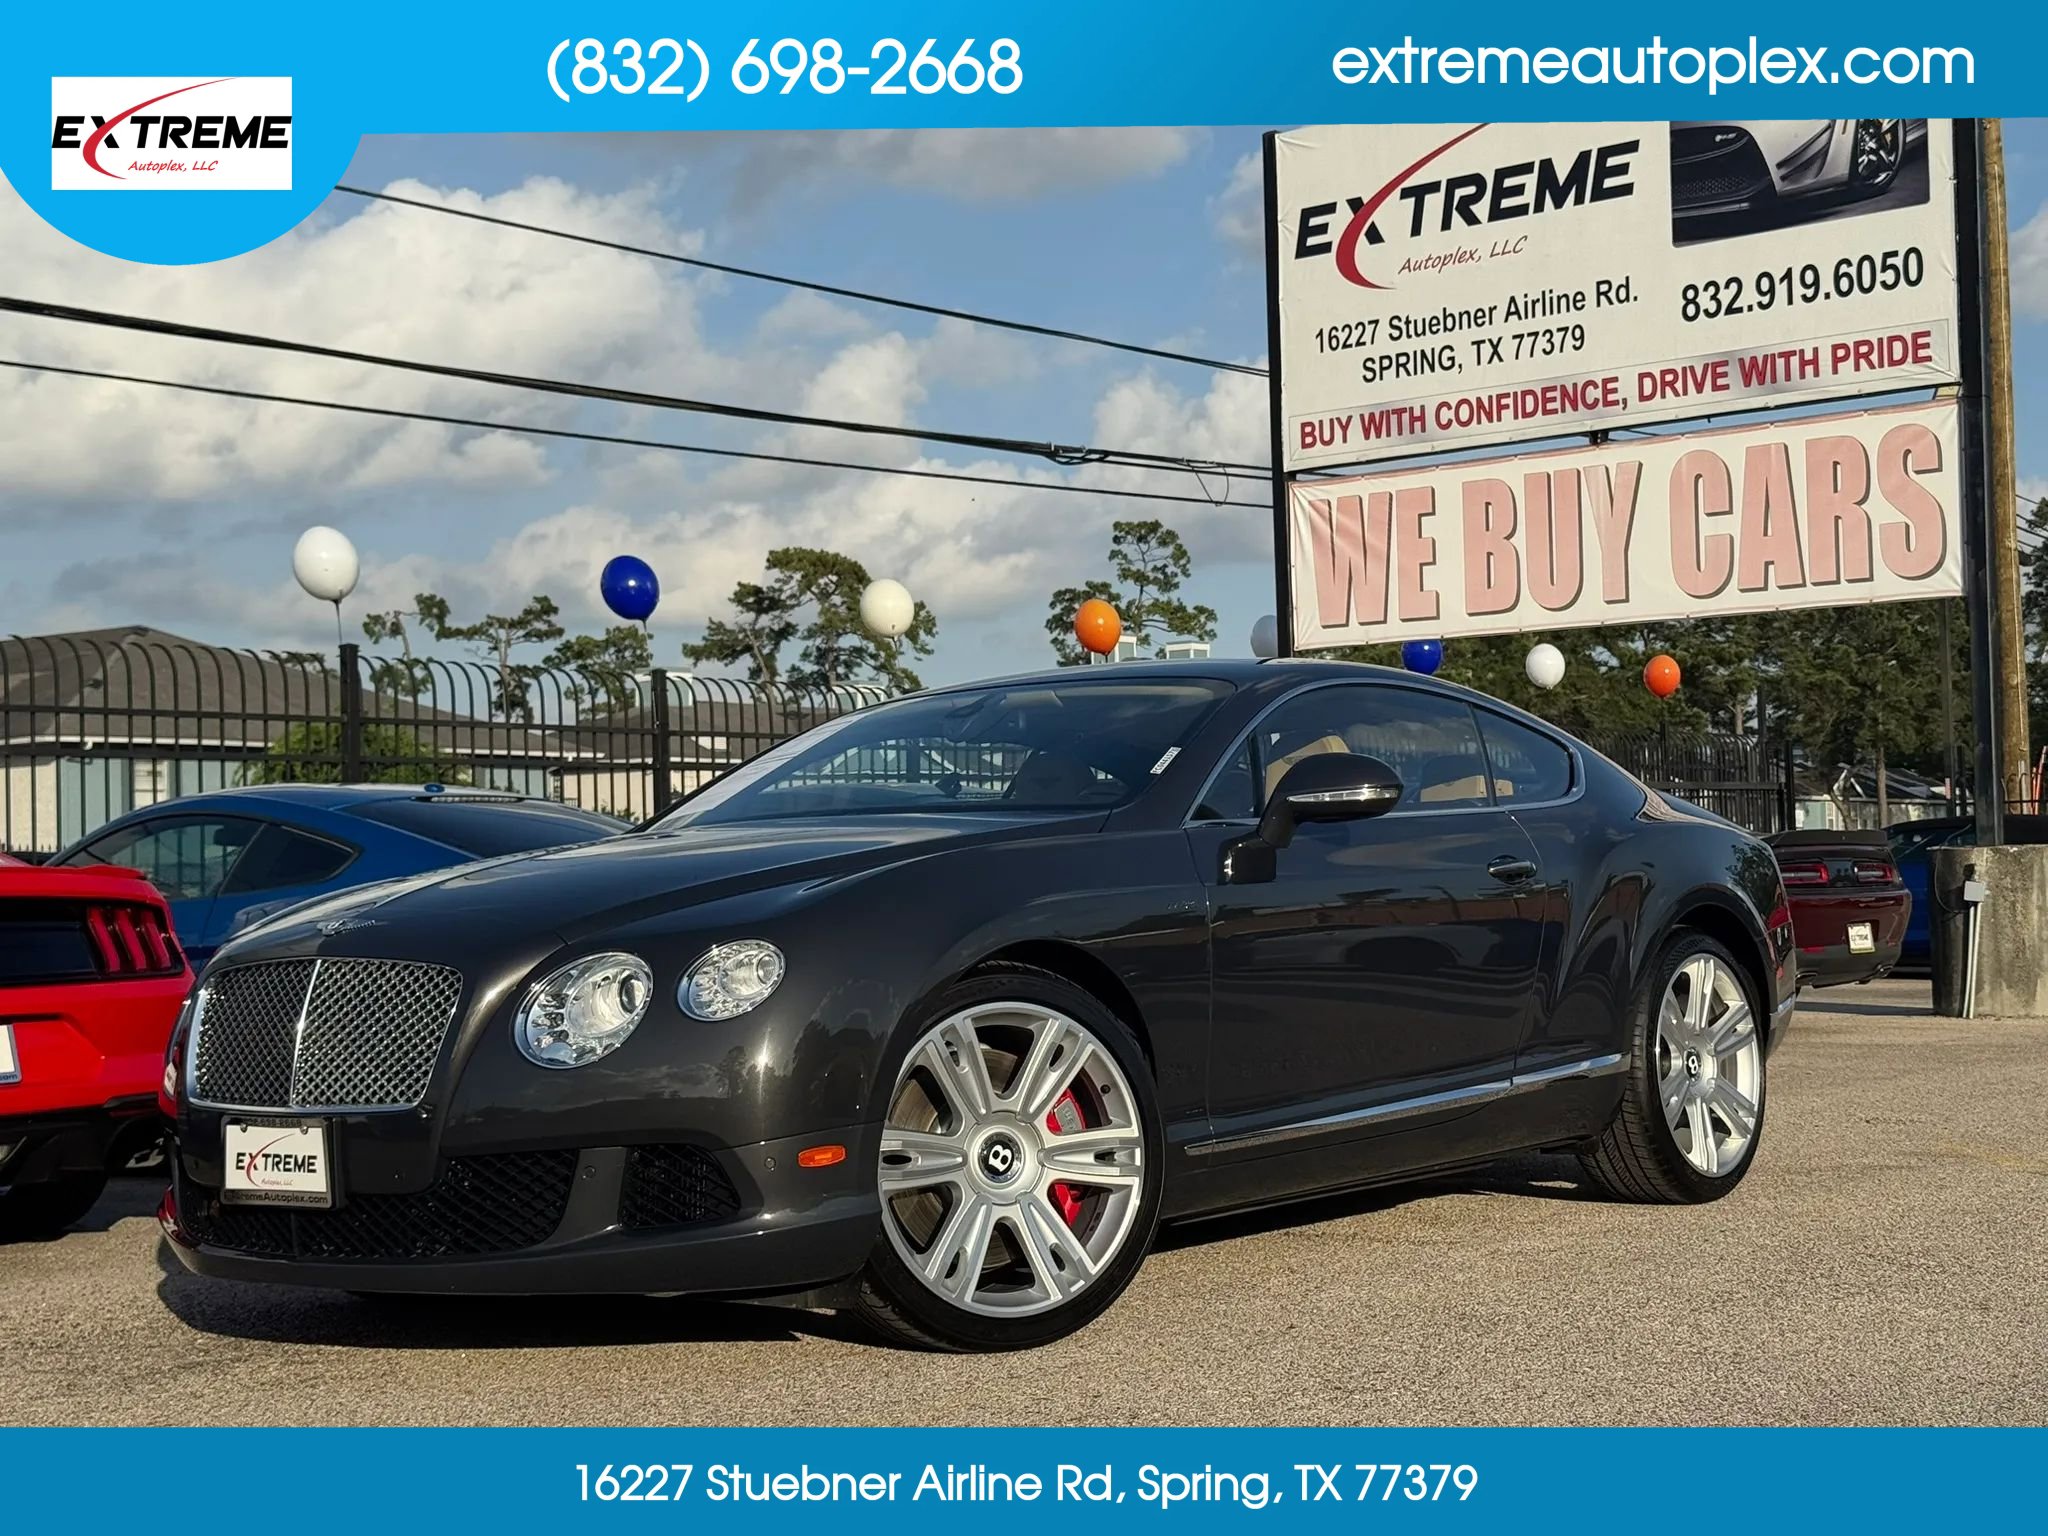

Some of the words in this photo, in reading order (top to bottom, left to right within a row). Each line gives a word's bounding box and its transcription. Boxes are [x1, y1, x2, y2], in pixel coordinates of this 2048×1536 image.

[1294, 139, 1641, 260] EXTREME
[1397, 246, 1482, 275] Autoplex,
[1489, 235, 1529, 259] LLC
[1681, 246, 1925, 323] 832.919.6050
[1315, 319, 1380, 353] 16227
[1388, 304, 1498, 342] Stuebner
[1503, 286, 1586, 323] Airline
[1595, 275, 1639, 308] Rd.
[1300, 413, 1353, 450] BUY
[1359, 404, 1427, 442] WITH
[1434, 375, 1629, 430] CONFIDENCE,
[1637, 359, 1730, 404] DRIVE
[1737, 346, 1821, 388] WITH
[1829, 330, 1933, 376] PRIDE
[1362, 344, 1464, 384] SPRING,
[1470, 336, 1505, 366] TX
[1511, 323, 1586, 361] 77379
[1312, 484, 1440, 628] WE
[1462, 459, 1643, 616] BUY
[1668, 423, 1947, 599] CARS
[235, 1152, 318, 1174] EXTREME
